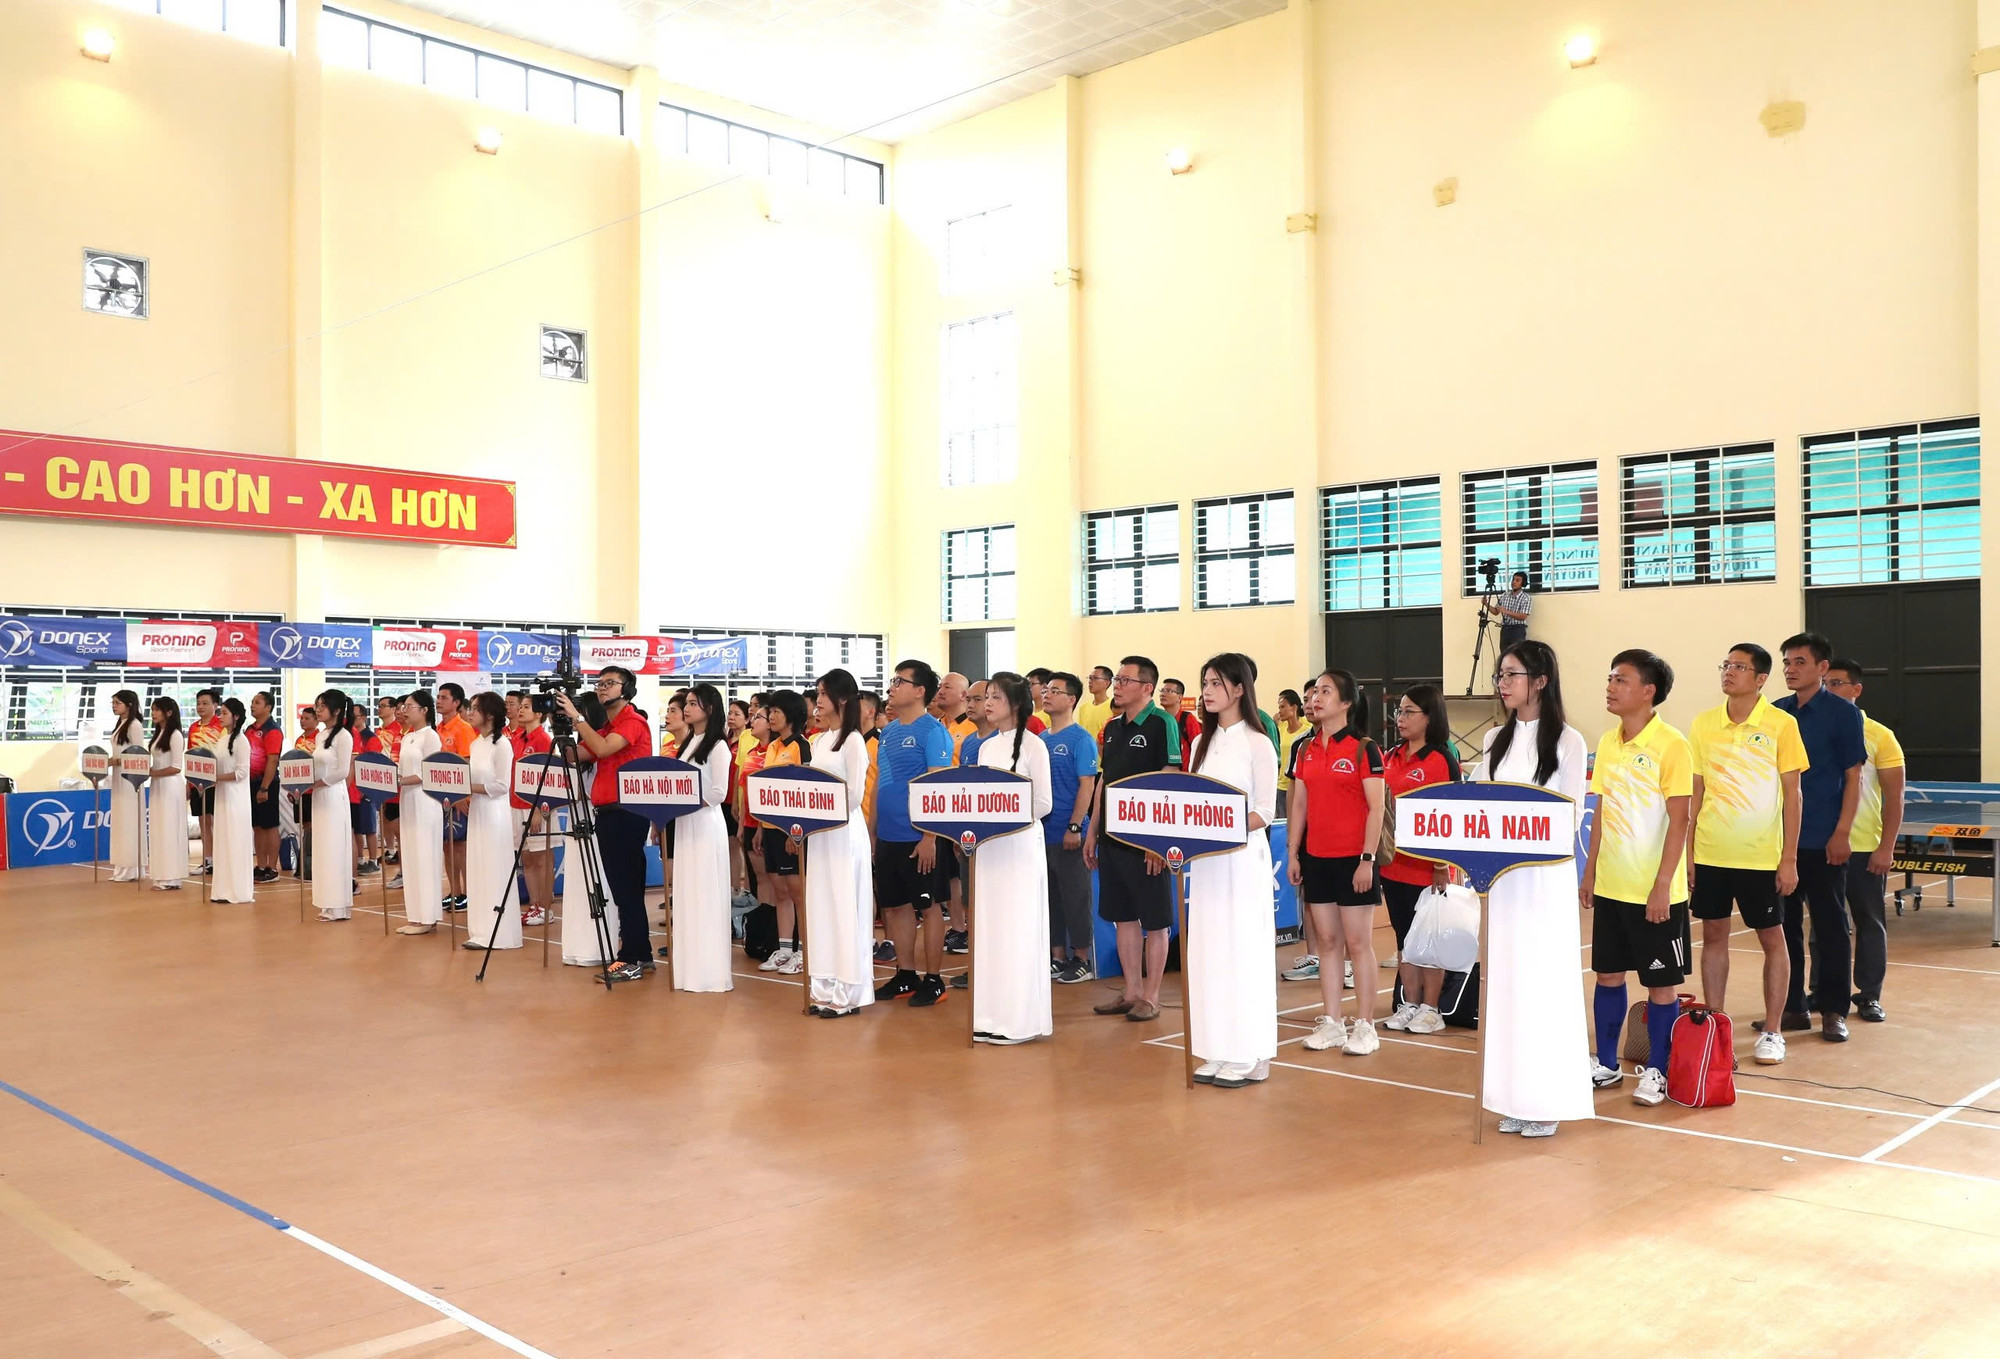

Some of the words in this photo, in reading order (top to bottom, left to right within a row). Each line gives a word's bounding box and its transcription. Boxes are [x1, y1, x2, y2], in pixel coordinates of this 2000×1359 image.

[46, 456, 150, 505] CAO
[169, 468, 270, 515] HƠN
[319, 481, 377, 522] XA
[391, 487, 477, 531] HƠN
[39, 631, 112, 645] DONEX
[142, 634, 207, 647] PRONING
[307, 636, 362, 650] DONEX
[75, 645, 108, 655] Sport
[384, 640, 437, 652] PRONING
[591, 648, 641, 658] PRONING
[335, 650, 359, 659] Sport
[543, 656, 561, 664] Spo
[360, 766, 370, 781] BÁO
[430, 769, 452, 787] TRỌNG
[453, 767, 464, 785] TÀI
[521, 768, 535, 785] BÁO
[536, 769, 555, 787] NÂN
[623, 775, 640, 795] BÁO
[642, 775, 655, 795] HÀ
[657, 776, 673, 798] NỘI
[675, 775, 693, 796] MỚI
[759, 785, 780, 807] BÁO
[782, 786, 806, 809] THÁI
[808, 788, 835, 811] BÌNH
[922, 791, 946, 813] BÁO
[952, 787, 972, 813] HẢI
[977, 792, 1020, 813] DƯƠNG
[1118, 797, 1146, 823] BÁO
[1152, 795, 1176, 825] HẢI
[1184, 800, 1234, 829] PHÒNG
[1414, 808, 1451, 838] BÁO
[1464, 809, 1491, 839] HÀ
[1502, 815, 1550, 841] NAM
[1954, 827, 1982, 837] 双鱼
[1889, 860, 1933, 871] OUBLE
[1933, 862, 1967, 873] FISH
